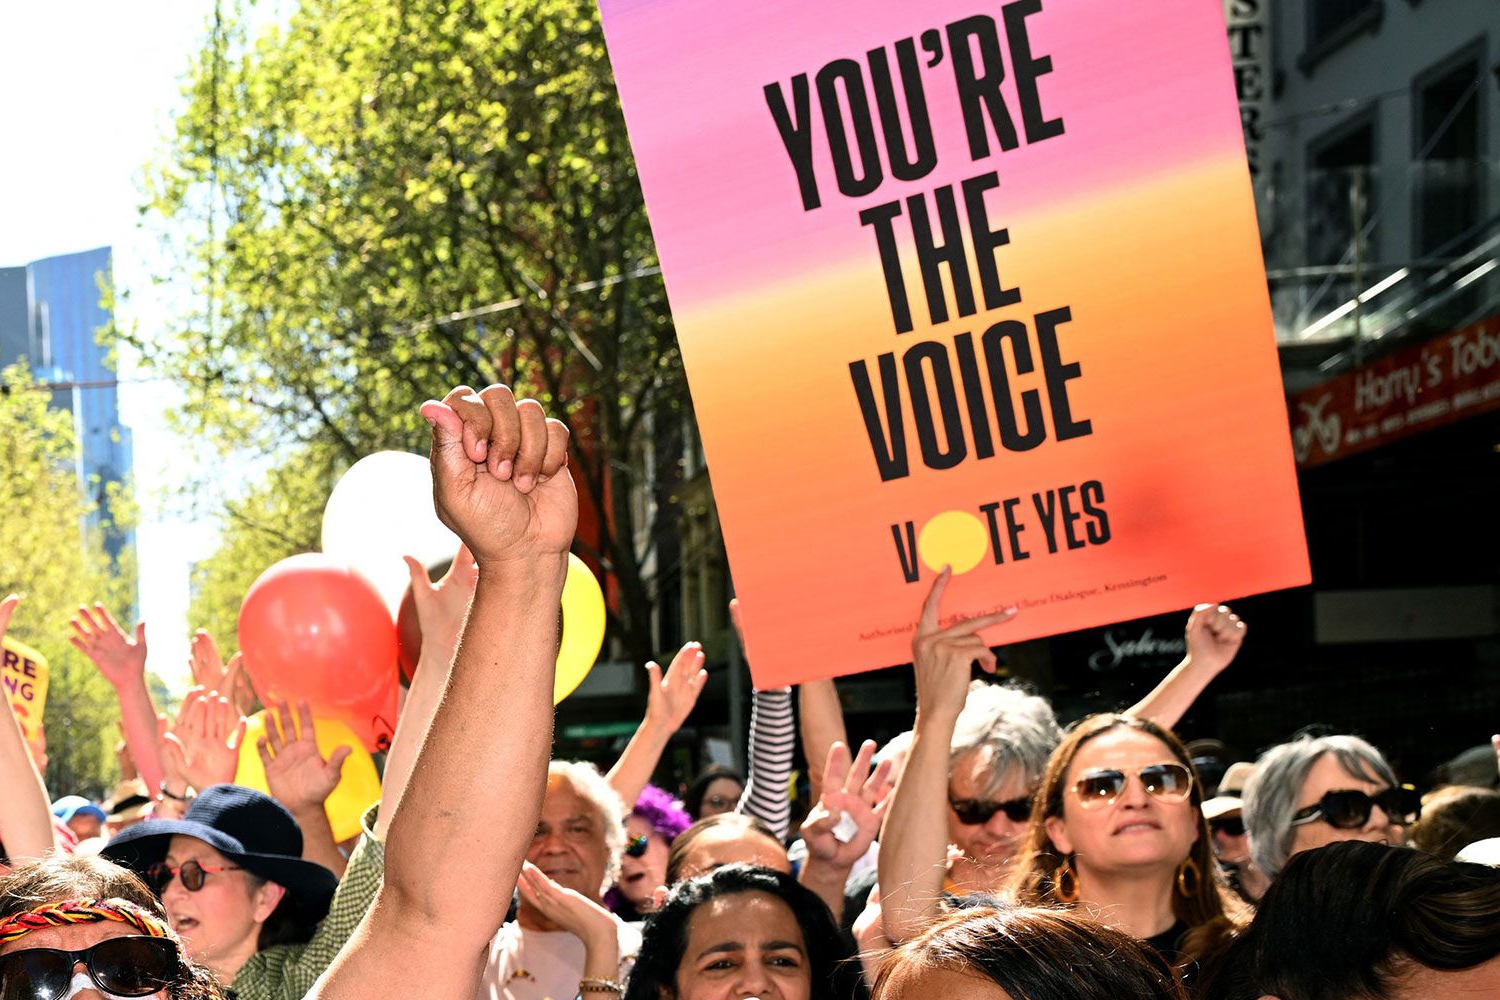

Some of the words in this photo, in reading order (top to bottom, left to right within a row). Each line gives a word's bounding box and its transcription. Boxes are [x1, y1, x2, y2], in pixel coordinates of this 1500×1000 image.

[763, 0, 1065, 212] YOU'RE
[859, 170, 1022, 335] THE
[849, 305, 1093, 483] VOICE
[1032, 480, 1112, 554] YES
